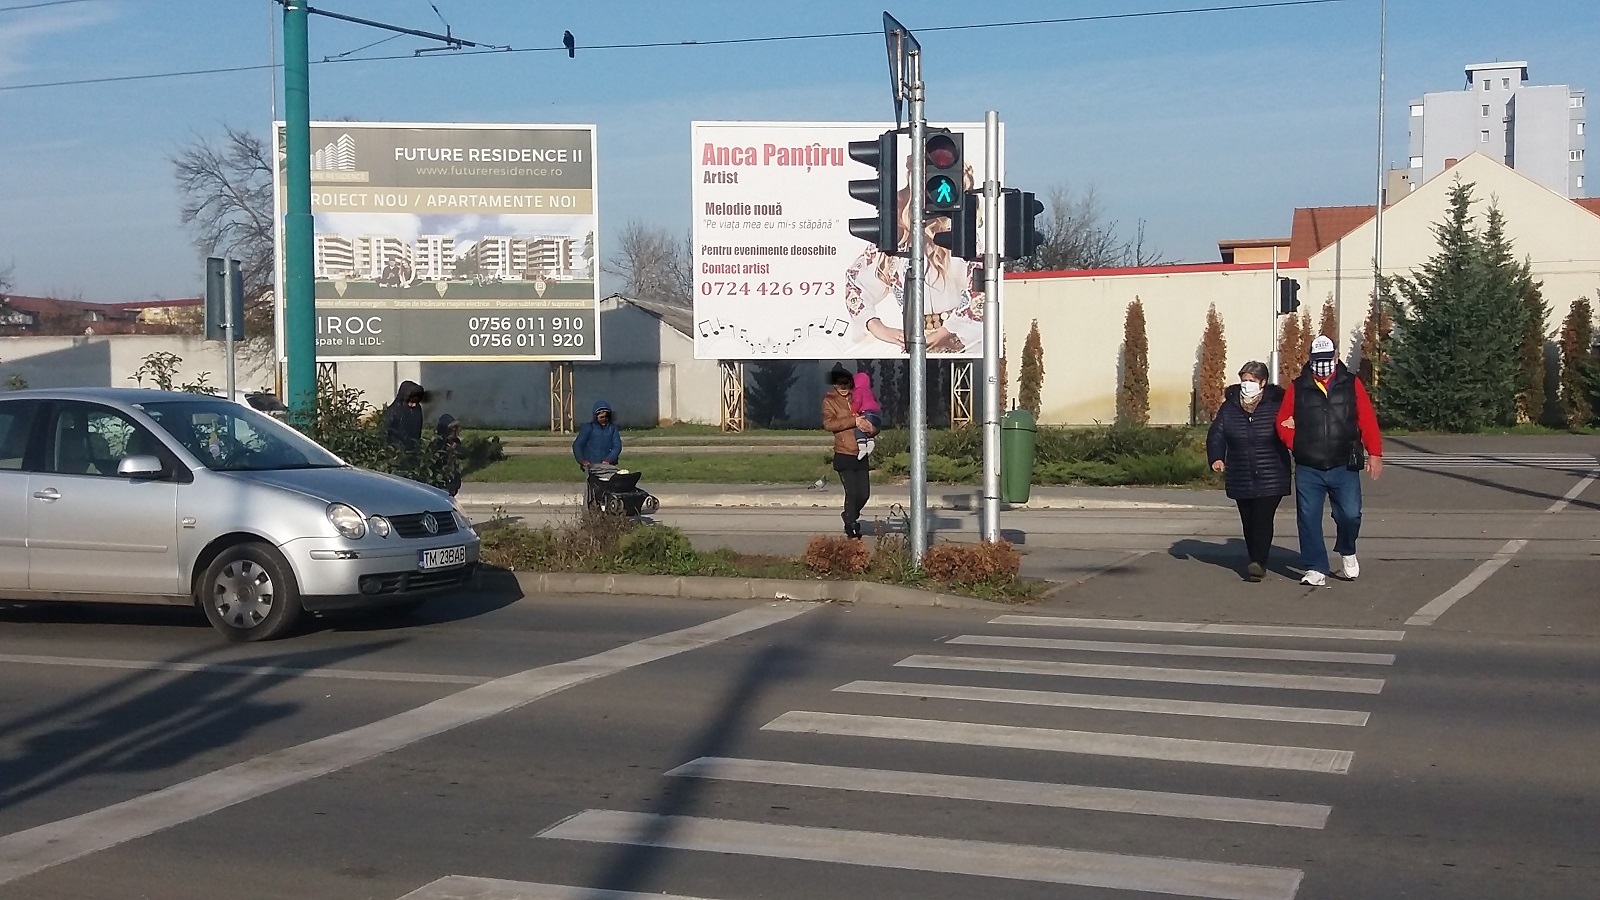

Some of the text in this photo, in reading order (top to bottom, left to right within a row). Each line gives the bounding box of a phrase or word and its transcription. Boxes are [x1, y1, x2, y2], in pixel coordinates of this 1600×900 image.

[394, 148, 582, 163] FUTURE RESIDENCE II
[702, 142, 844, 173] Anca Panțîru
[416, 165, 562, 176] www.futureresidence.ro
[703, 170, 738, 184] Artist
[311, 194, 576, 208] ROIECT NOU / APARTAMENTE NOI
[705, 202, 782, 216] Melodie nouă
[701, 245, 836, 256] Pentru evenimente deosebite
[702, 262, 770, 274] Contact artist
[701, 282, 835, 296] 0724 426 973
[318, 316, 382, 334] IROC
[468, 317, 584, 331] 0756 011 910
[346, 336, 355, 345] la
[469, 333, 584, 347] 0756 011 920
[424, 550, 437, 566] TM
